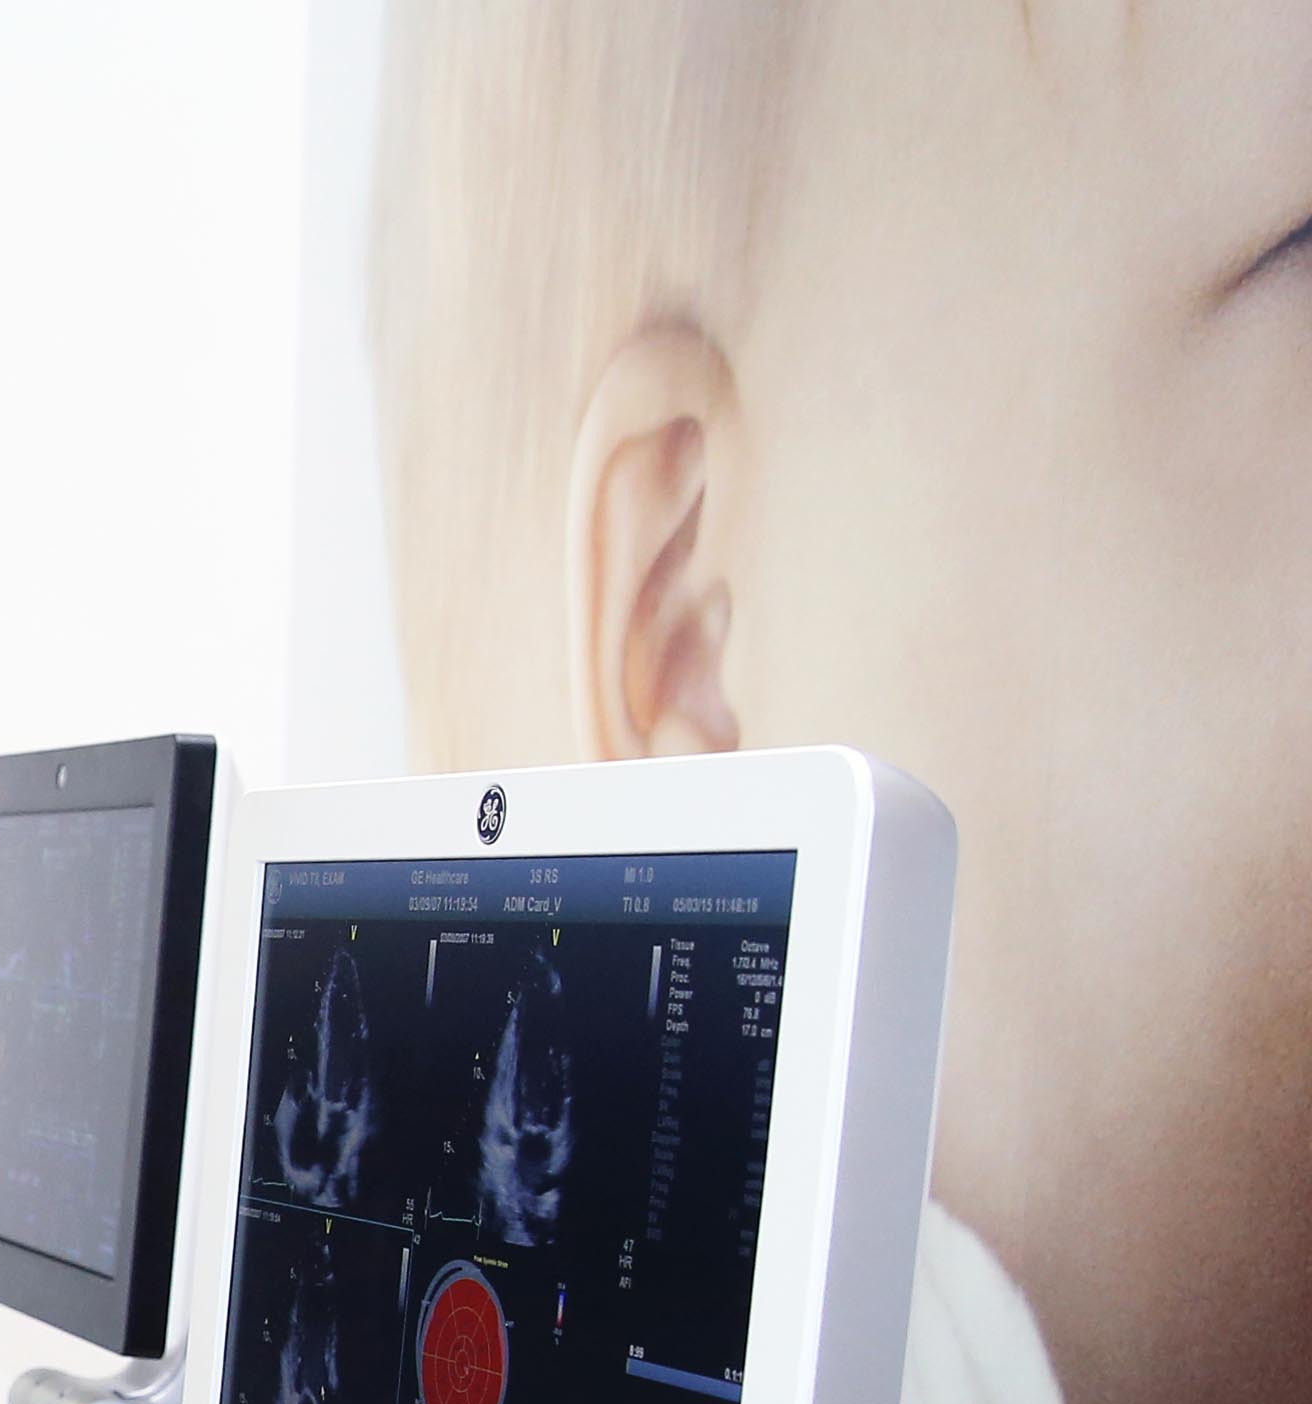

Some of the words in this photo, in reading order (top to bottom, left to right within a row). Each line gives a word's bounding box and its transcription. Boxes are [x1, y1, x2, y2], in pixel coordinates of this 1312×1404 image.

[411, 871, 424, 884] GE
[426, 871, 469, 885] Healthcare
[504, 897, 526, 912] ADM
[667, 1003, 684, 1016] FPS
[618, 1254, 633, 1270] HR
